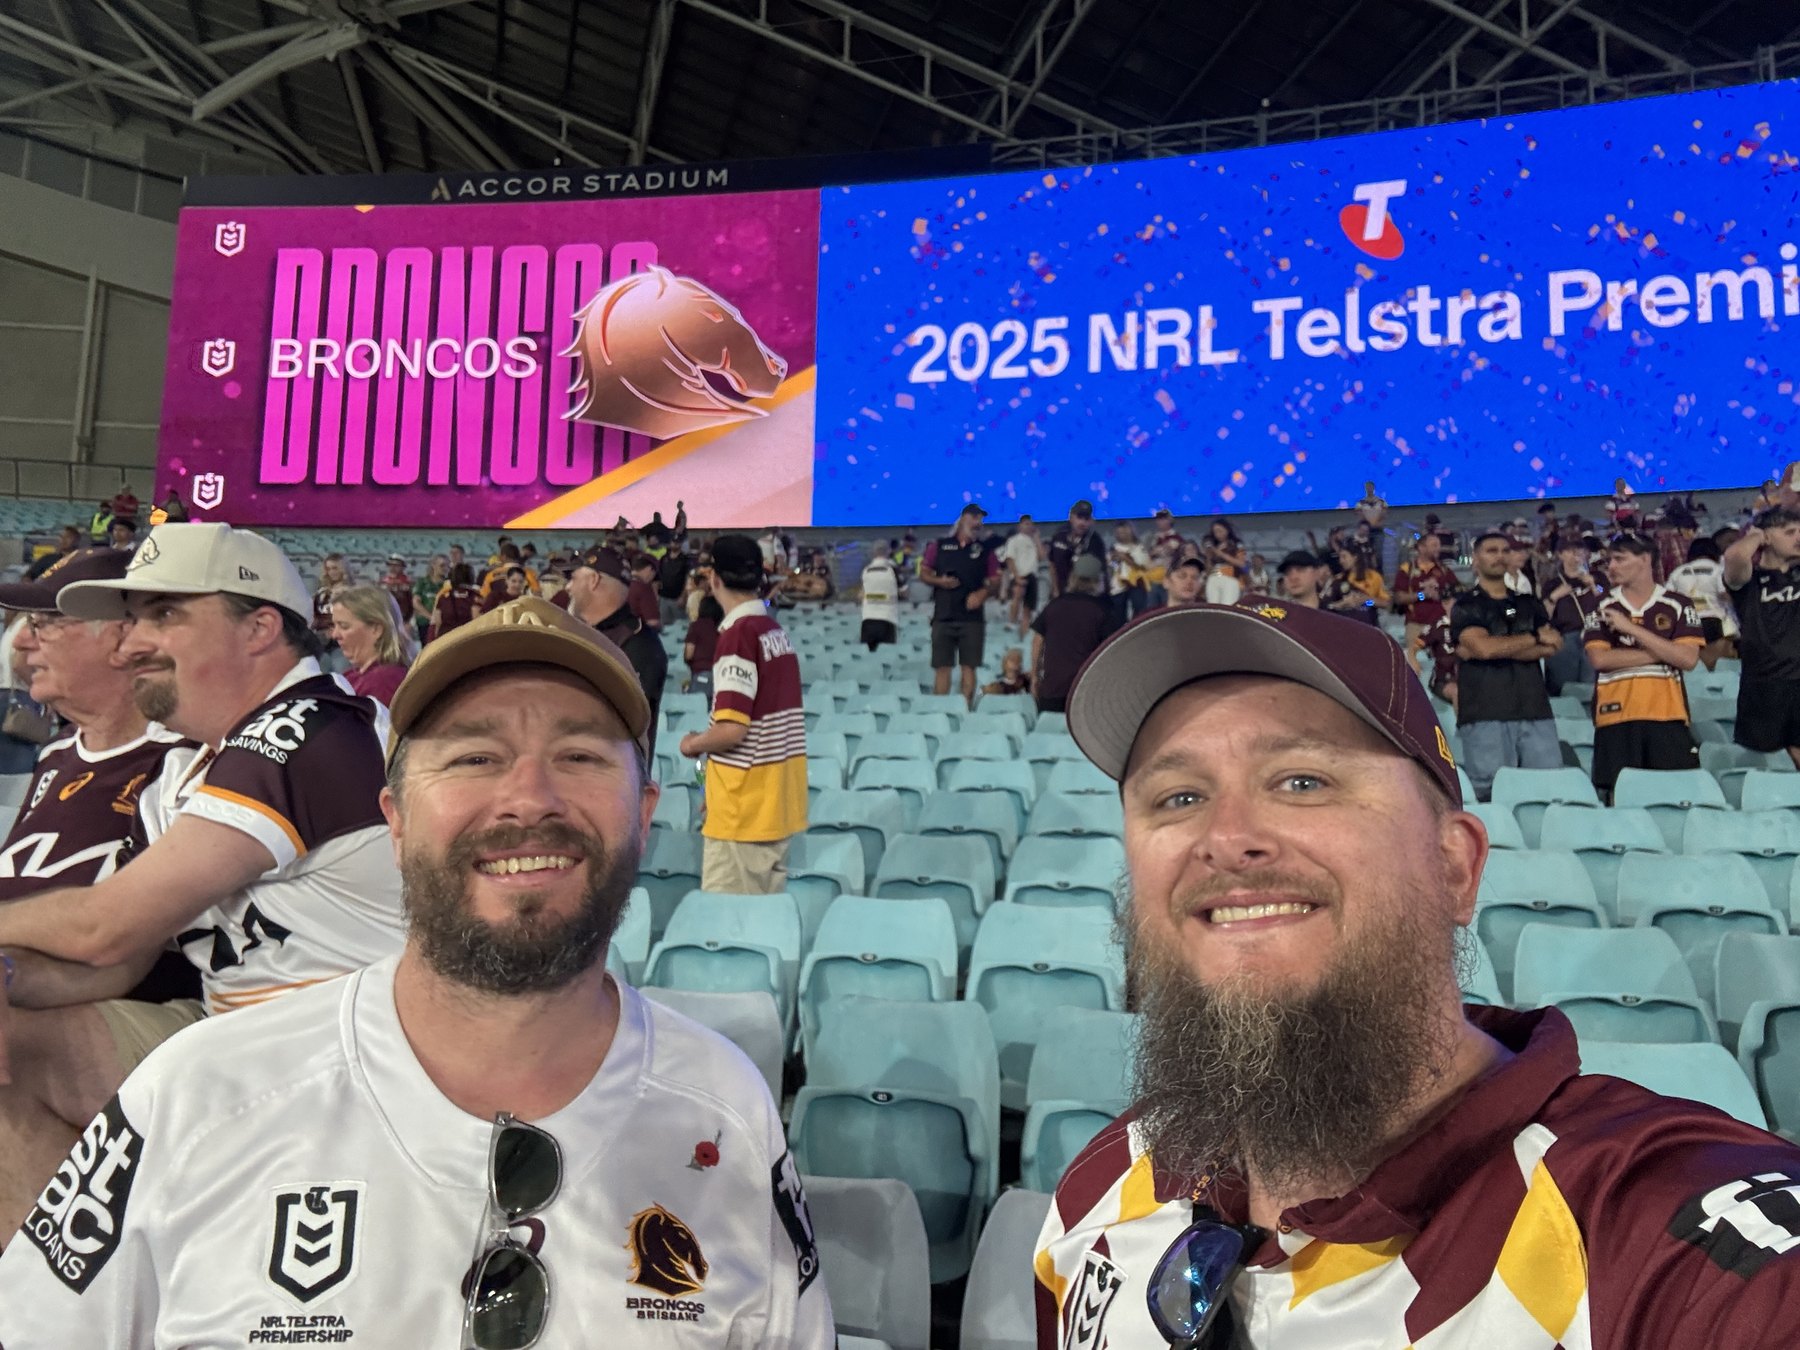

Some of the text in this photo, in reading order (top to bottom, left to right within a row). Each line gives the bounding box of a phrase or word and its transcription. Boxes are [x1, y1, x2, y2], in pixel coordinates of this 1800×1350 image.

[458, 169, 728, 197] ACCOR STADIUM
[908, 316, 1071, 384] 2025
[1087, 304, 1240, 374] NRL
[1252, 285, 1522, 361] Telstra
[270, 336, 538, 379] BRONCOS
[226, 736, 289, 765] SAVINGS
[24, 1206, 86, 1281] LOANS
[626, 1297, 705, 1314] BRONCOS
[637, 1310, 699, 1322] BRISBANE
[260, 1315, 346, 1329] NRL TELSTRA
[249, 1329, 354, 1344] PREMIERSHIP
